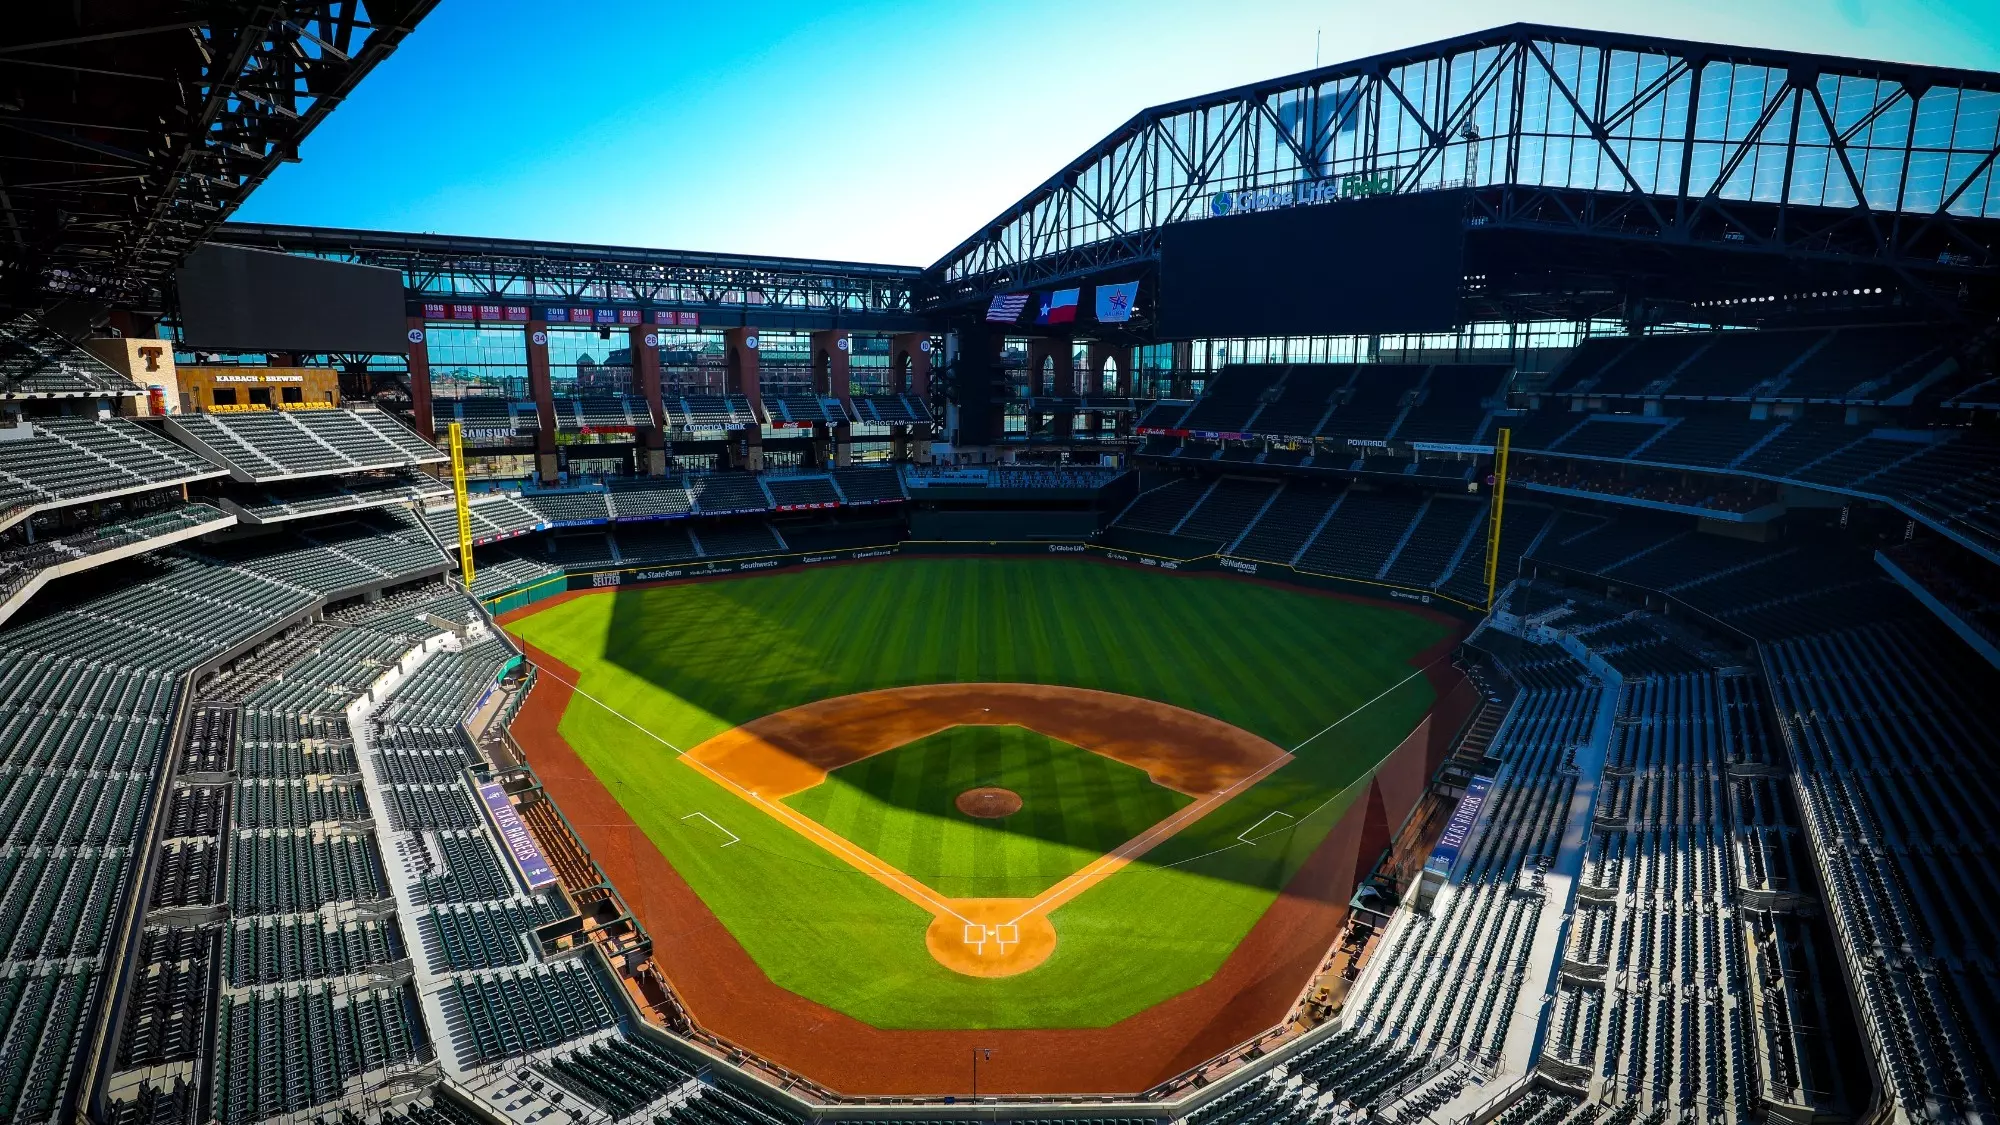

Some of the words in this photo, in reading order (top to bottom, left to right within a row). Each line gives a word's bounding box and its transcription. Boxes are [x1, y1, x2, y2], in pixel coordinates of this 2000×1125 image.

[1237, 187, 1293, 211] Globe
[1297, 179, 1337, 204] Life
[1341, 170, 1393, 199] Field
[410, 332, 422, 340] 42
[534, 334, 545, 342] 34
[139, 346, 163, 372] T
[724, 422, 746, 430] Bank
[461, 428, 517, 438] SAMSUNG
[1347, 438, 1388, 448] POWERADE
[740, 561, 774, 570] Southwest
[592, 576, 621, 587] SELTZER
[1454, 795, 1482, 825] RANGERS
[494, 804, 518, 828] TEXAS
[1442, 824, 1468, 848] TEXAS
[505, 826, 537, 860] RANGERS
